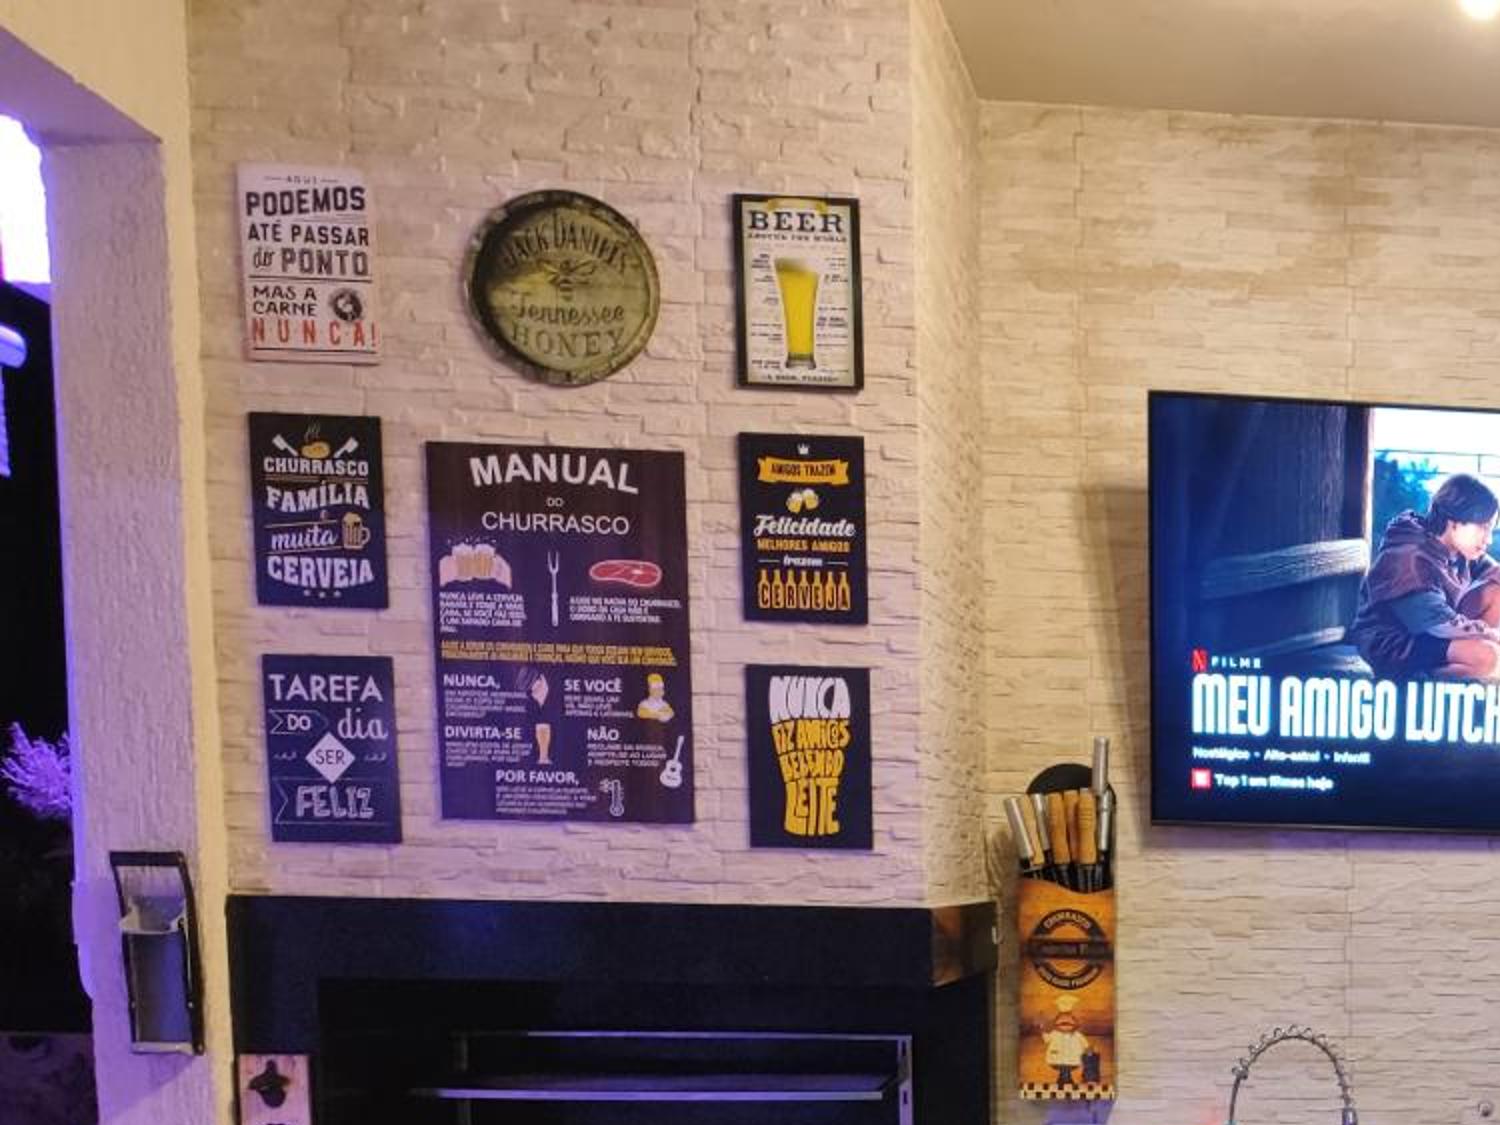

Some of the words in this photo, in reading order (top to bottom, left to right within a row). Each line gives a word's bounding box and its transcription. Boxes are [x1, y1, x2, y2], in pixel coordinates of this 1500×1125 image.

[246, 186, 365, 216] PODEMOS
[247, 219, 282, 242] ATÉ
[291, 225, 369, 246] PASSAR
[748, 210, 844, 233] BEER
[281, 248, 368, 276] PONTO
[253, 285, 296, 300] MAS
[304, 287, 317, 301] A
[253, 301, 318, 317] CARNE
[512, 290, 624, 325] Tennessee
[512, 321, 624, 357] HONEY
[263, 456, 369, 476] CHURRASCO
[469, 453, 639, 494] MANUAL
[266, 479, 371, 513] FAMÍLIA
[546, 497, 564, 507] DO
[481, 511, 630, 535] CHURRASCO
[753, 515, 857, 537] Felicidade
[271, 524, 338, 550] muita
[757, 538, 808, 552] MELHORES
[811, 540, 850, 553] AMIGOS
[267, 555, 374, 589] CERVEJA
[760, 583, 850, 609] CERVEJA
[1211, 655, 1261, 669] FILME
[268, 674, 383, 702] TAREFA
[443, 674, 500, 689] NUNCA,
[564, 678, 580, 692] SE
[584, 677, 622, 693] VOCÊ
[769, 675, 851, 725] NUNCA
[1192, 673, 1272, 736] MEU
[1279, 676, 1398, 740] AMIGO
[287, 714, 311, 731] DO
[337, 707, 389, 740] dia
[445, 725, 522, 740] DIVIRTA-SE
[587, 725, 620, 741] NÃO
[315, 748, 345, 765] SER
[495, 769, 526, 783] POR
[529, 771, 579, 785] FAVOR,
[1213, 773, 1240, 789] Top
[296, 785, 375, 819] FELIZ
[784, 777, 840, 836] LEITE
